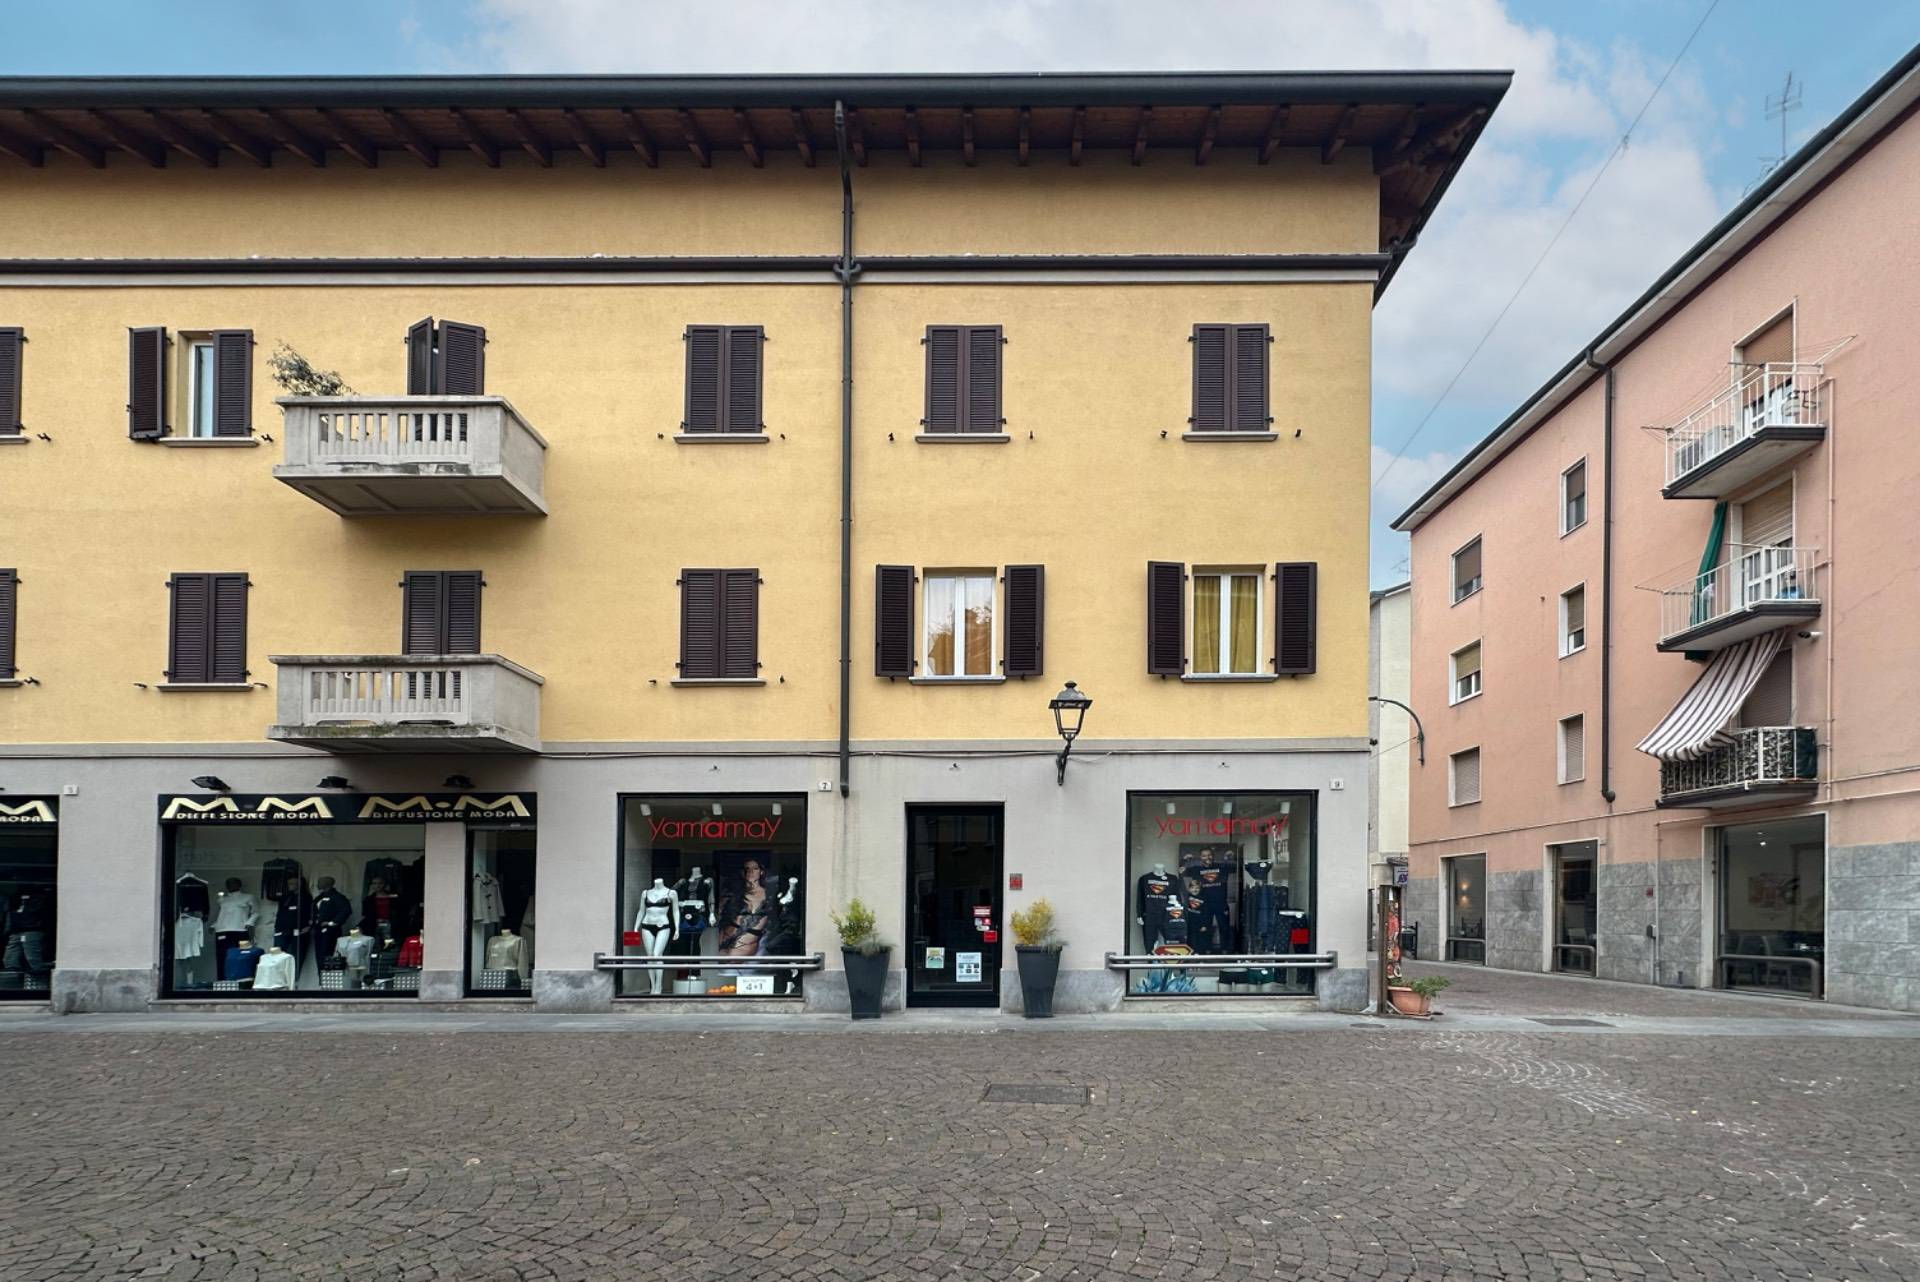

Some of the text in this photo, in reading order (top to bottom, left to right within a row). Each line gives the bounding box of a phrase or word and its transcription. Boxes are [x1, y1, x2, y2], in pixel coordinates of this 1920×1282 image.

[272, 811, 320, 820] MODA
[372, 810, 516, 819] DIFFUSIONE MODA
[648, 817, 782, 841] yamamay
[1154, 815, 1290, 839] yamamay
